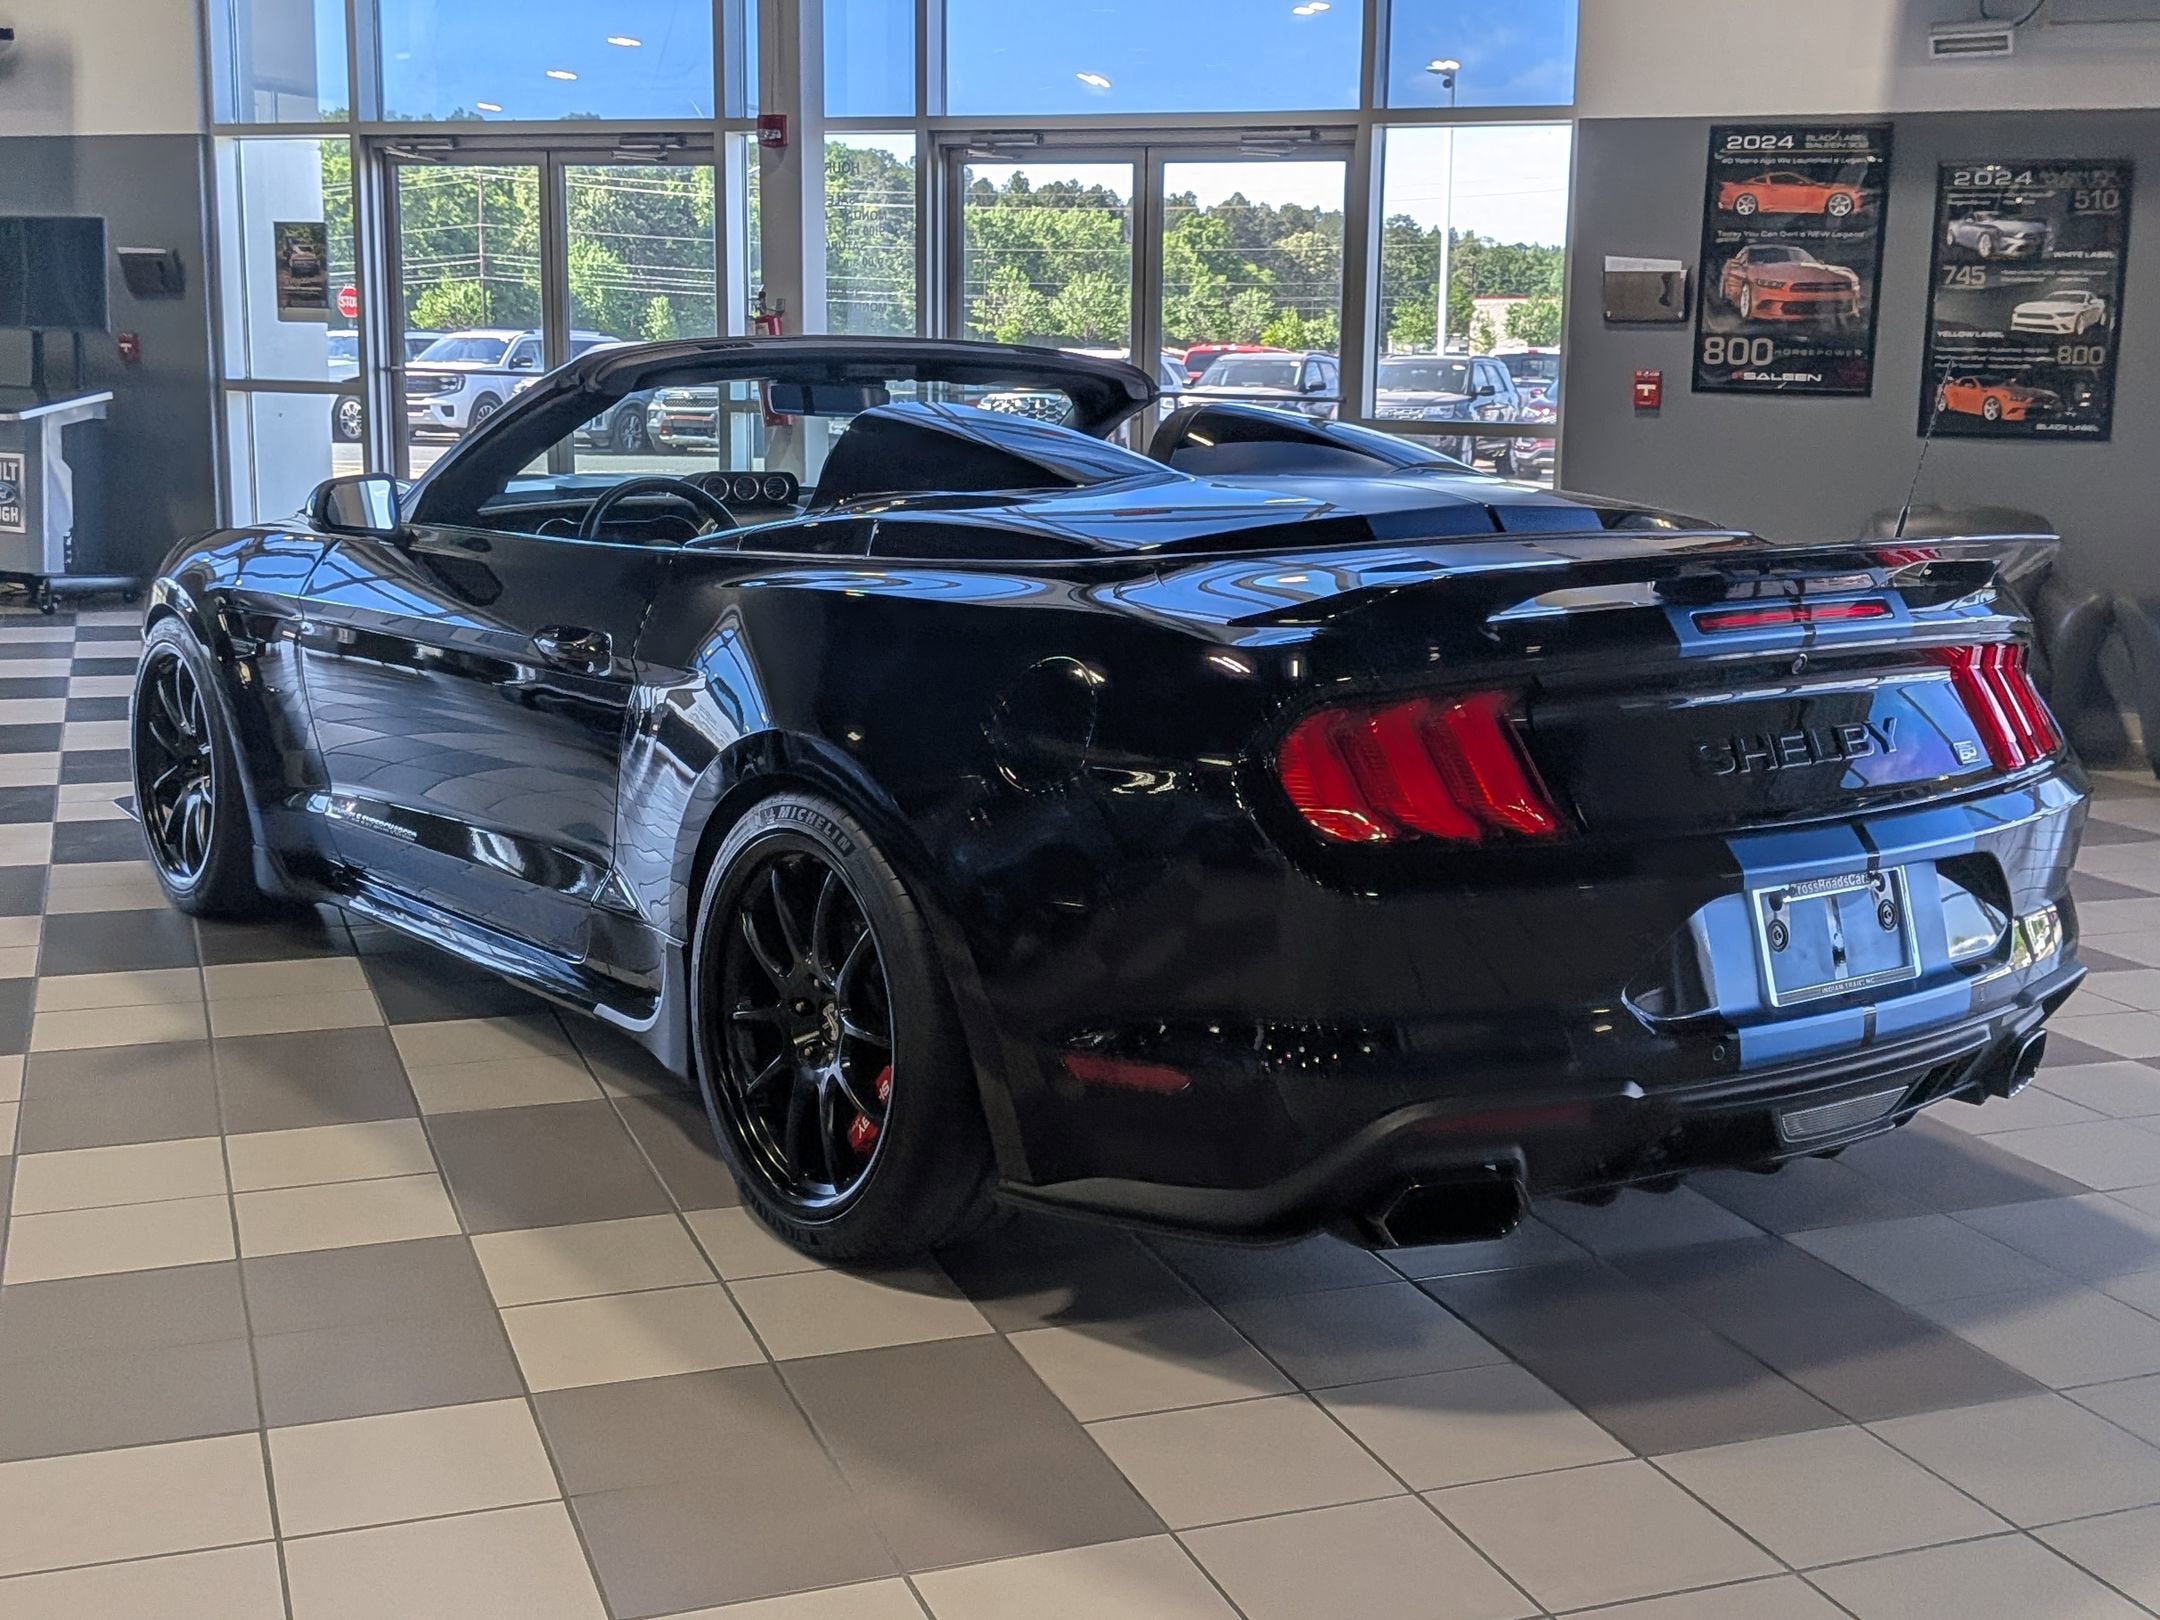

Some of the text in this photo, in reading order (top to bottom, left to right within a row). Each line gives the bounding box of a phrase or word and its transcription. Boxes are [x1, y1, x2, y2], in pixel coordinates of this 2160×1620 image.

[1726, 135, 1795, 149] 2024
[1953, 170, 2032, 186] 2024
[2074, 190, 2120, 209] 510
[1760, 230, 1778, 238] Can
[2053, 251, 2115, 259] WHITE LABEL
[1942, 265, 1986, 285] 745
[1703, 336, 1774, 366] 800
[2057, 346, 2105, 365] 800
[1743, 371, 1822, 382] SALEEN
[2036, 423, 2100, 432] BLACK LABEL
[1700, 717, 1897, 775] SHELBY
[777, 805, 853, 852] MICHELIN
